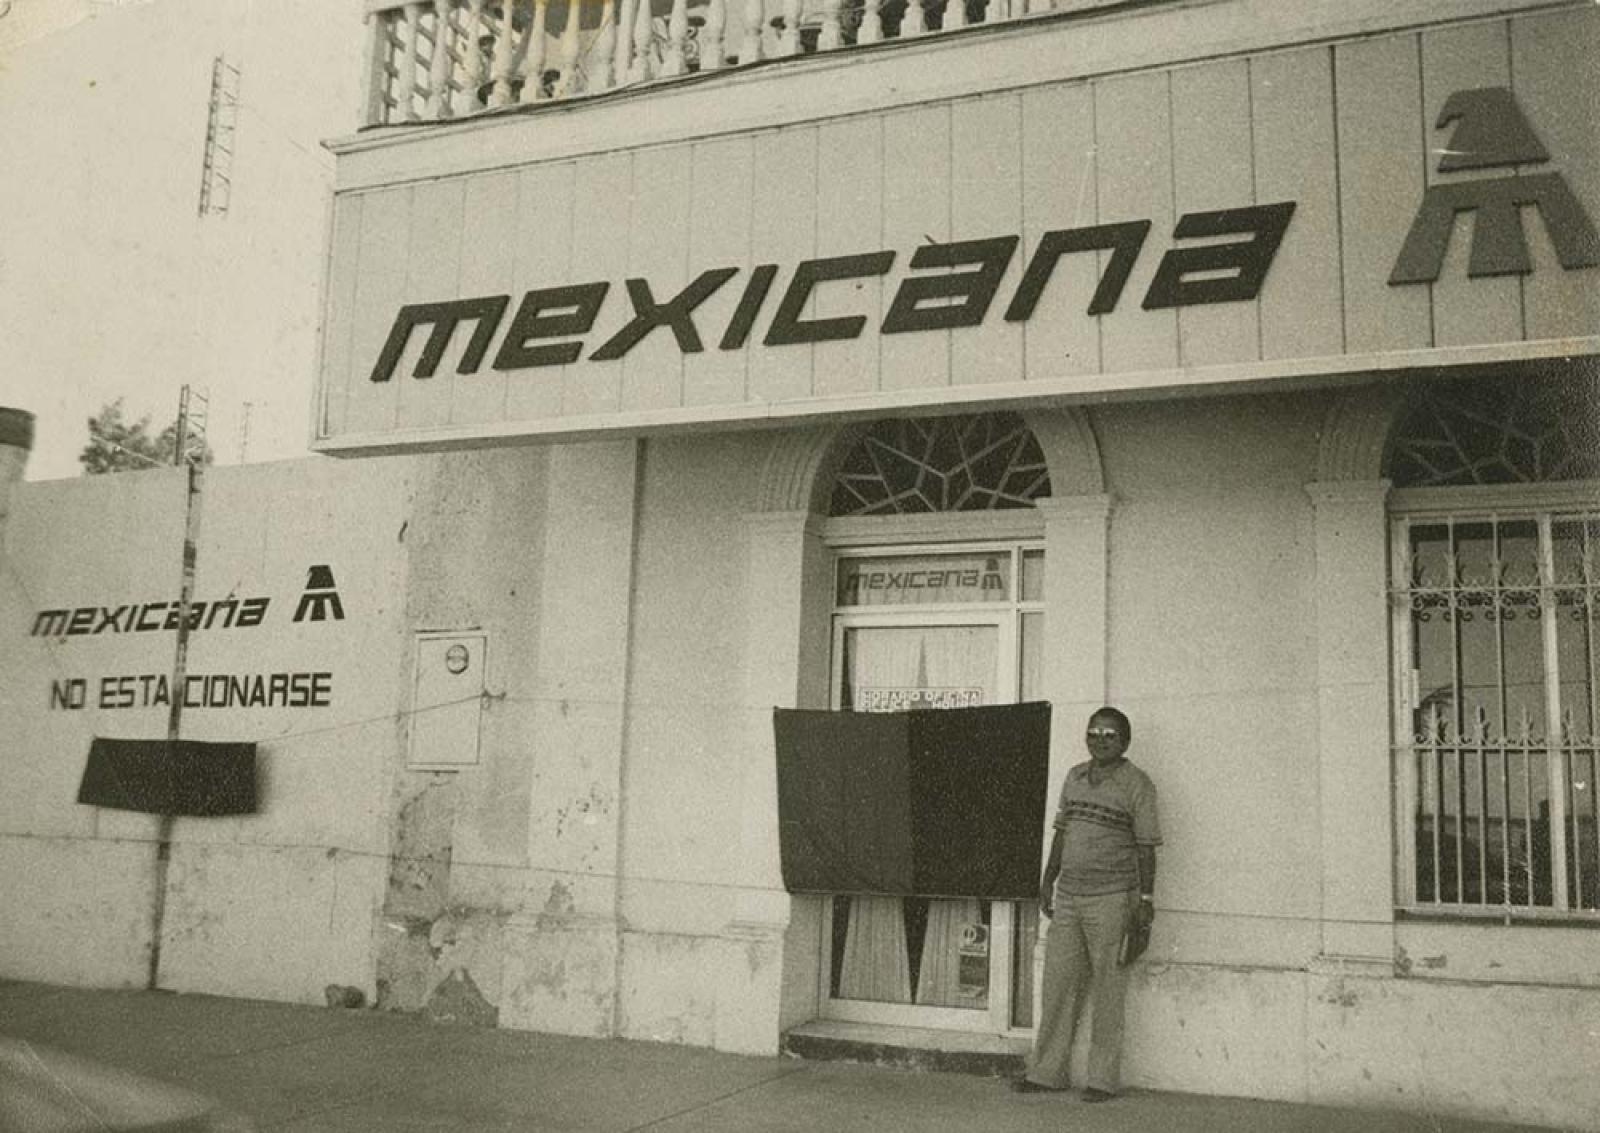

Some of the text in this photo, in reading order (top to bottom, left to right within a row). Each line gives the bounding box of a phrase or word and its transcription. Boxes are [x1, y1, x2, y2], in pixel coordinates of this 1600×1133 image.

[371, 202, 1296, 382] mexicana
[847, 570, 979, 590] mexicana
[31, 598, 270, 636] mexicana
[51, 678, 87, 710] NO
